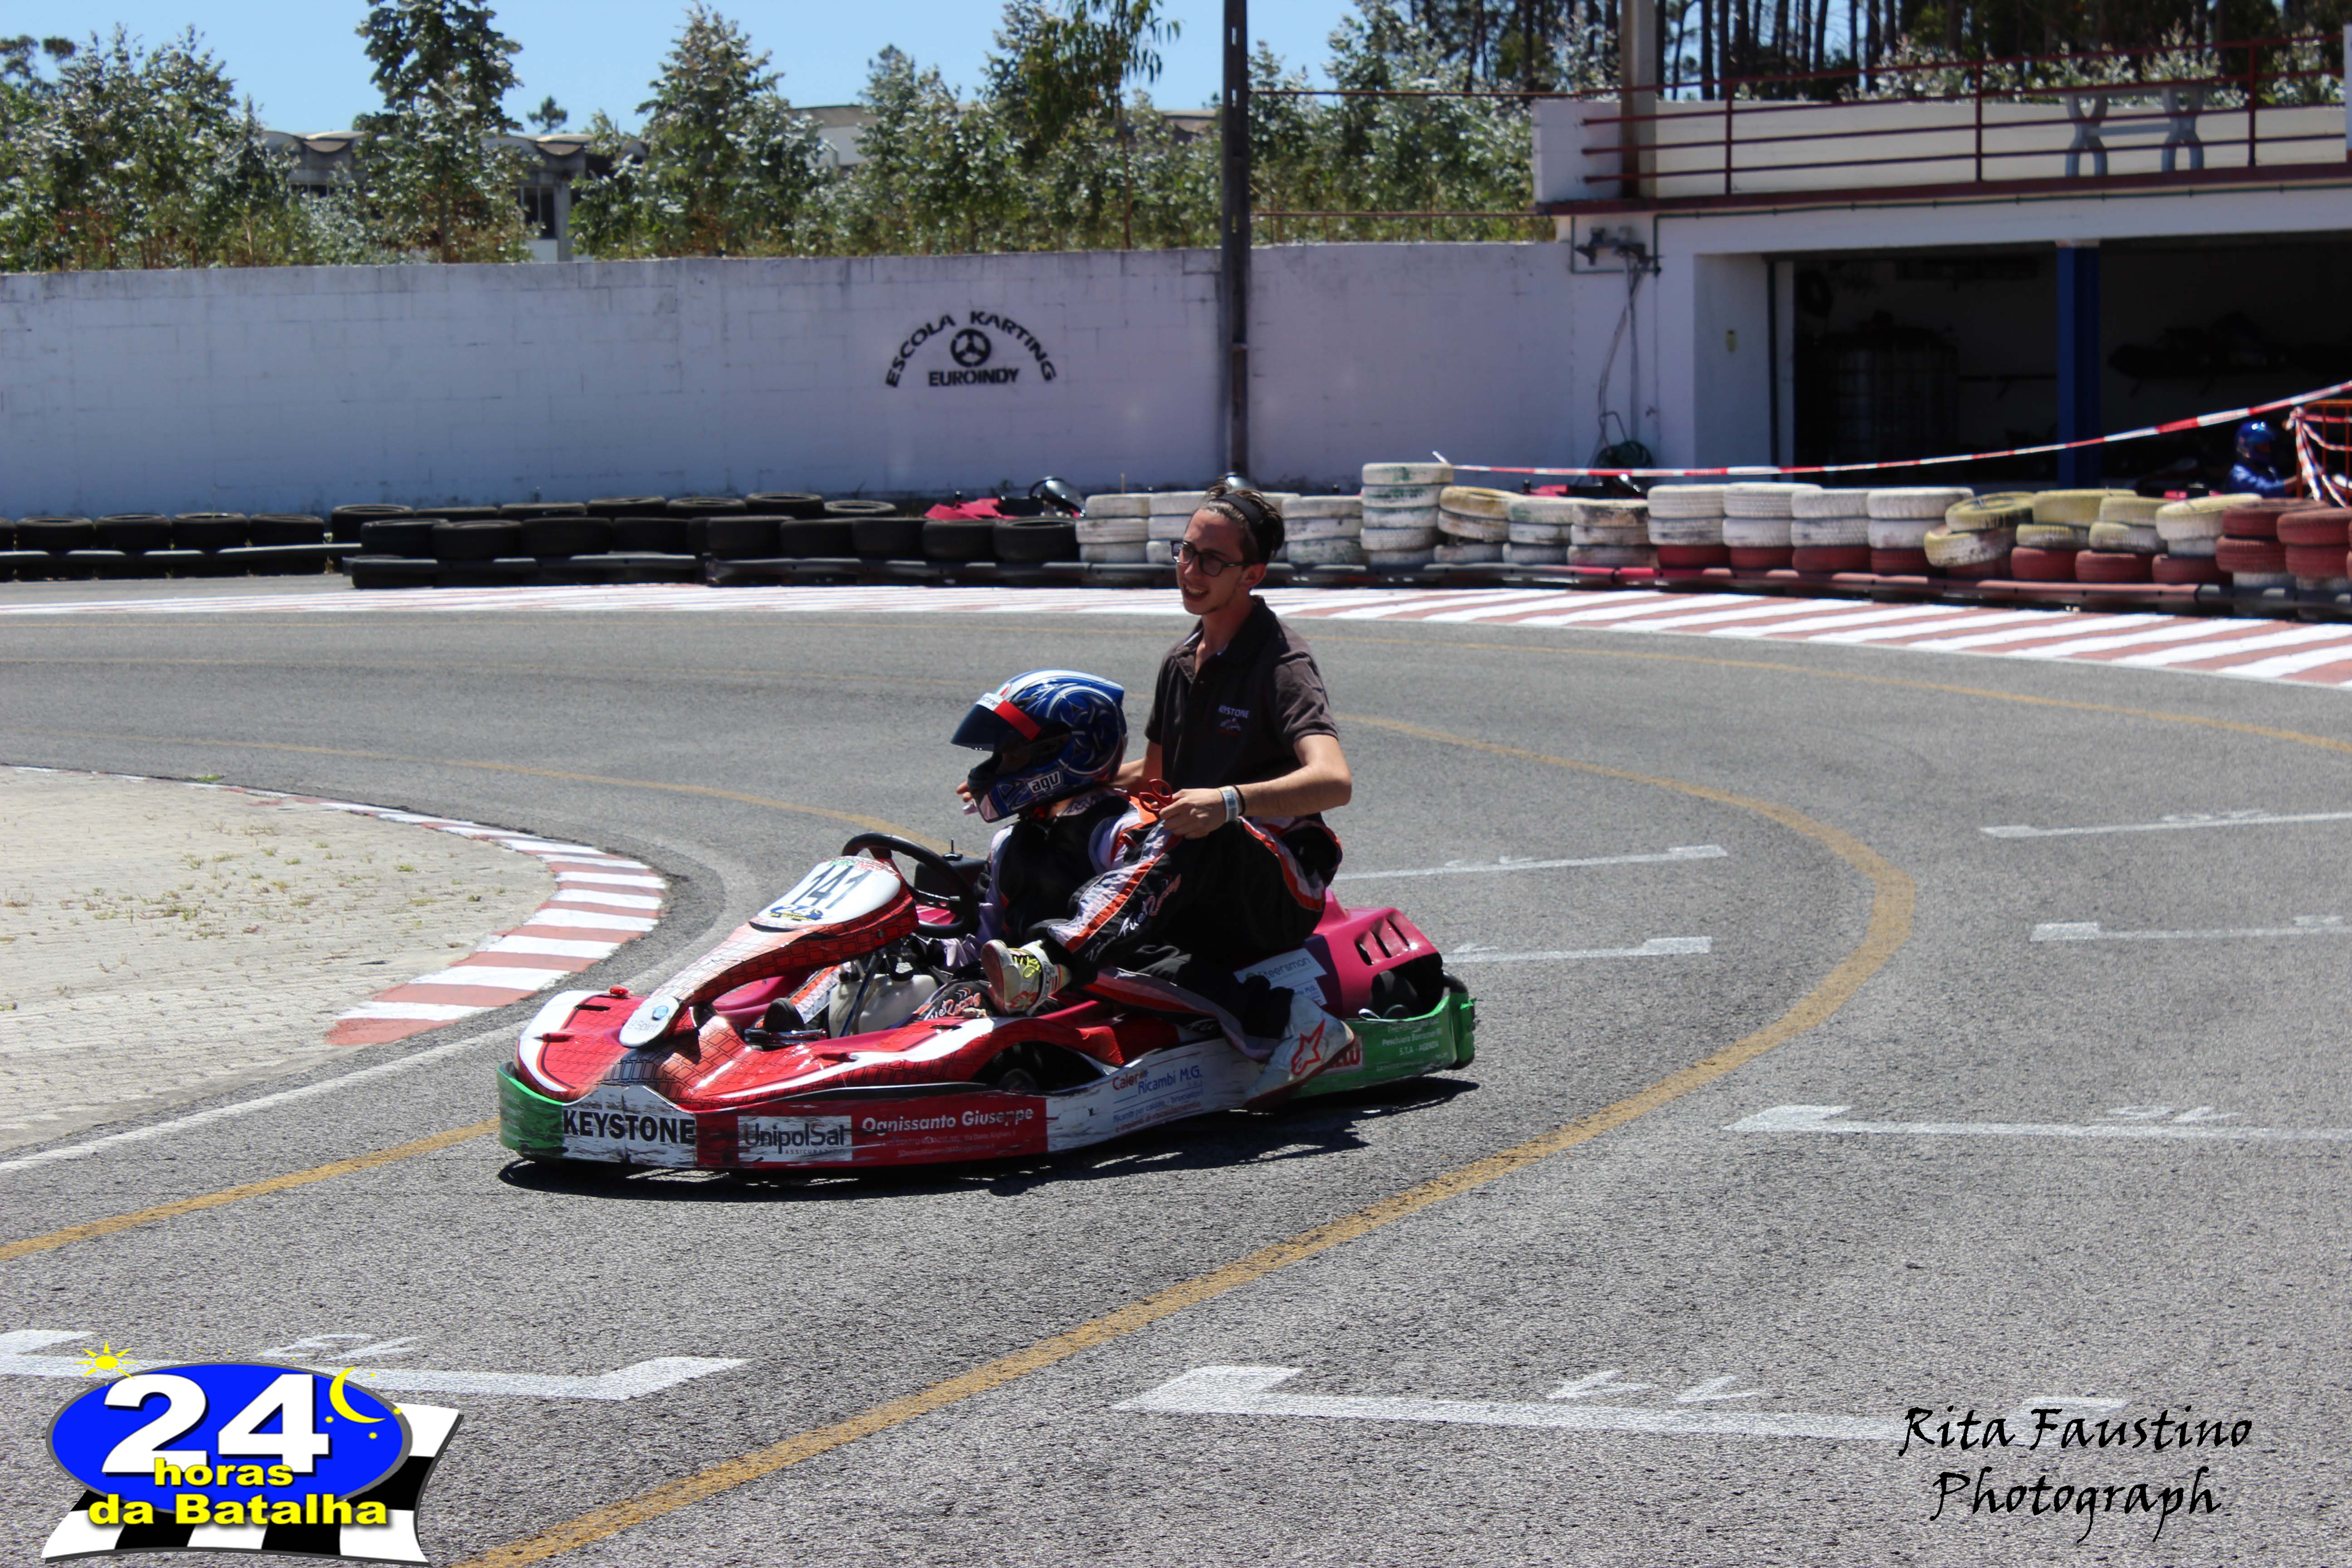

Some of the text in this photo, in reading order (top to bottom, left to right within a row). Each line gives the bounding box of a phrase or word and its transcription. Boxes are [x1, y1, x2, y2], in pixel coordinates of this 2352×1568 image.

[886, 311, 1057, 387] ESCOLA KARTING
[928, 368, 1019, 387] EUROINDY
[1032, 773, 1058, 792] agv
[790, 865, 874, 909] 141
[1138, 1065, 1202, 1094] Ricambi M.G.
[563, 1110, 696, 1145] KEYSTONE
[862, 1115, 956, 1136] Ognissanto
